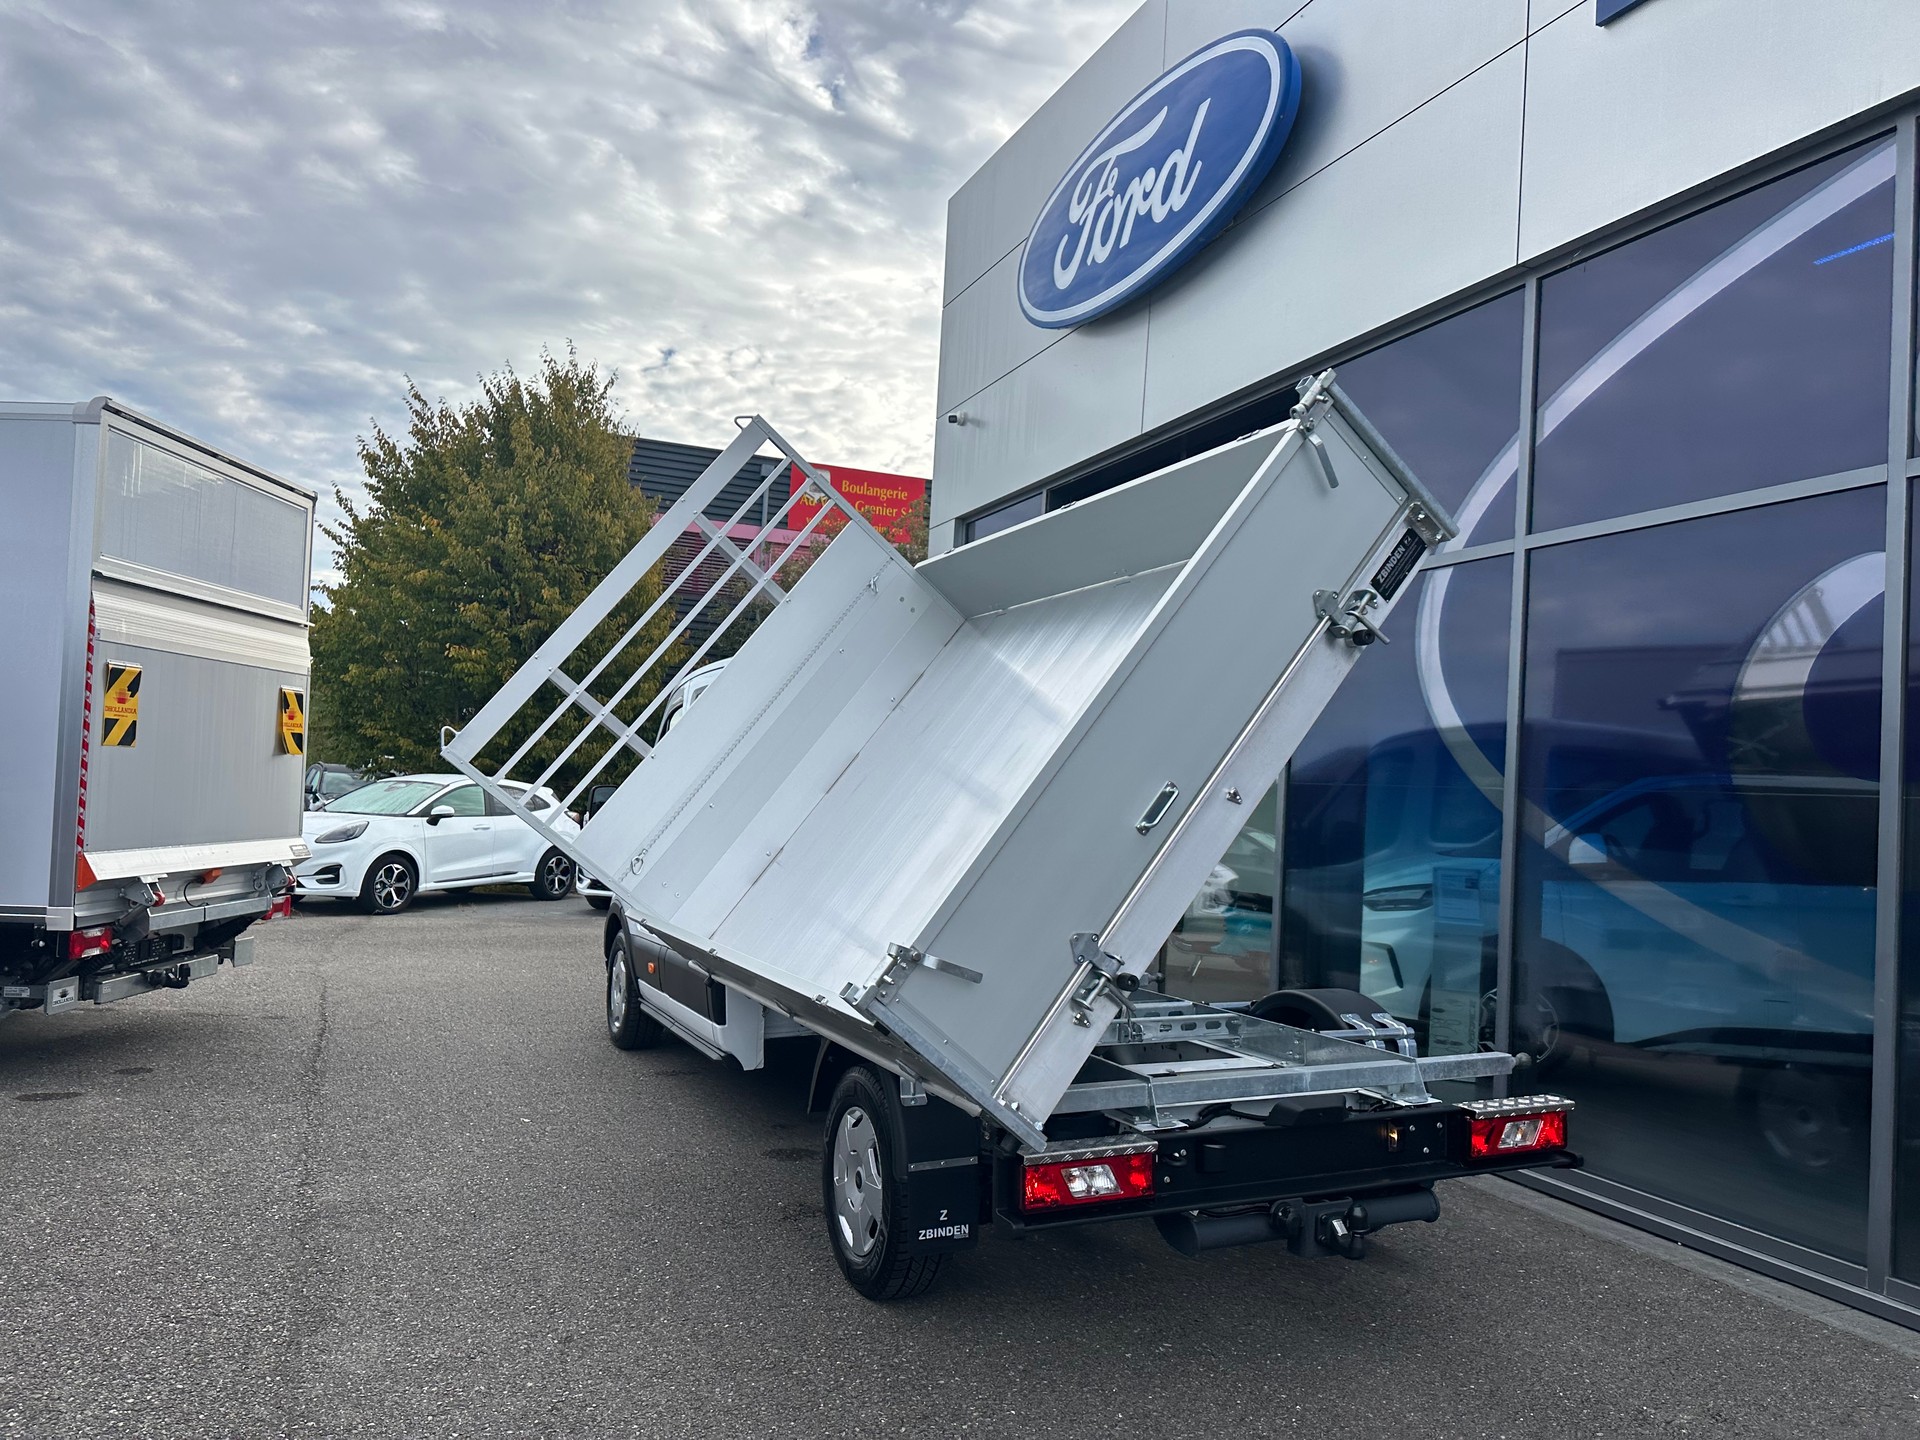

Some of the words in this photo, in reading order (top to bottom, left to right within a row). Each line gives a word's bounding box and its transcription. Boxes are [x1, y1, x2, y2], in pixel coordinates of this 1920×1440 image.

[1054, 98, 1211, 289] Ford
[841, 480, 908, 501] Boulangerie
[855, 500, 898, 517] Grenier
[1377, 545, 1406, 584] ZBINDEN
[940, 1209, 948, 1221] Z
[918, 1224, 969, 1240] ZBINDEN
